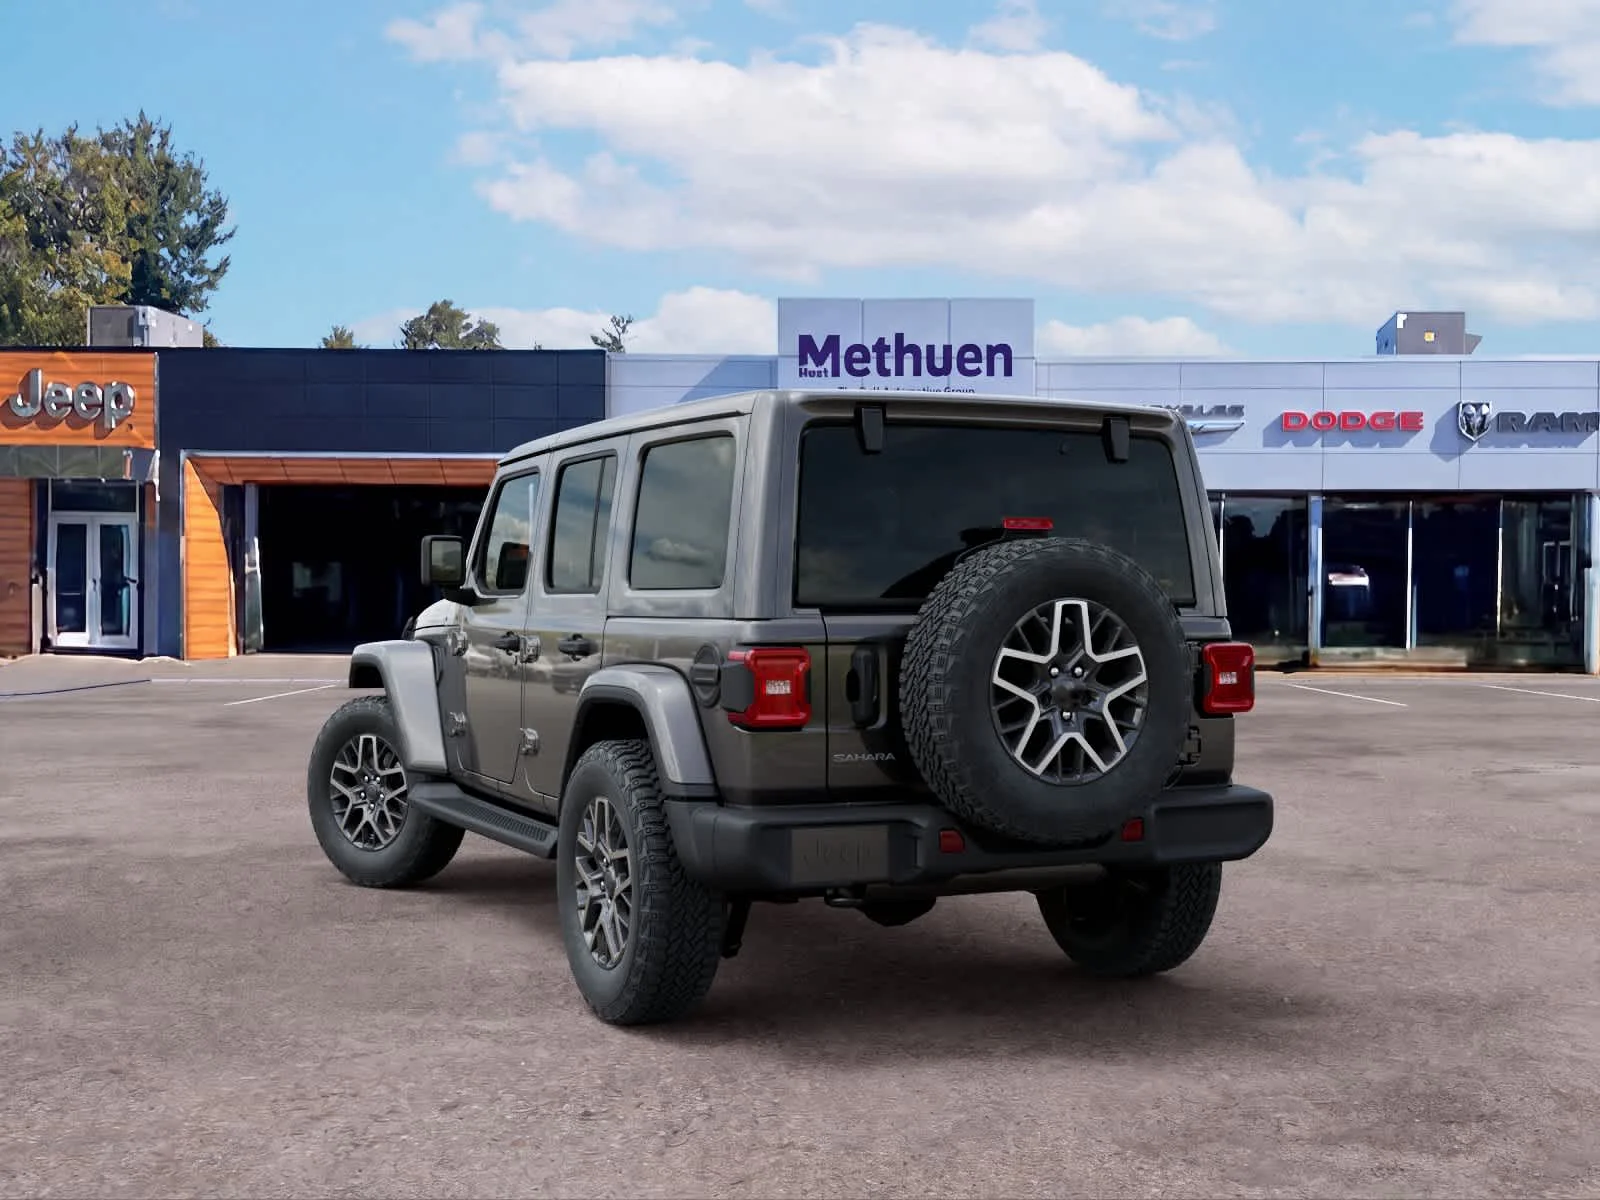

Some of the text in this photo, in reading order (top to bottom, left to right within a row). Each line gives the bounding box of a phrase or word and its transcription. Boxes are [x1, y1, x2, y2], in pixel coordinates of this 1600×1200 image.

[798, 332, 1013, 378] Methuen
[9, 367, 135, 430] Jeep
[1281, 410, 1424, 432] DODGE
[1497, 411, 1600, 433] RAM
[832, 752, 896, 763] SAHARA
